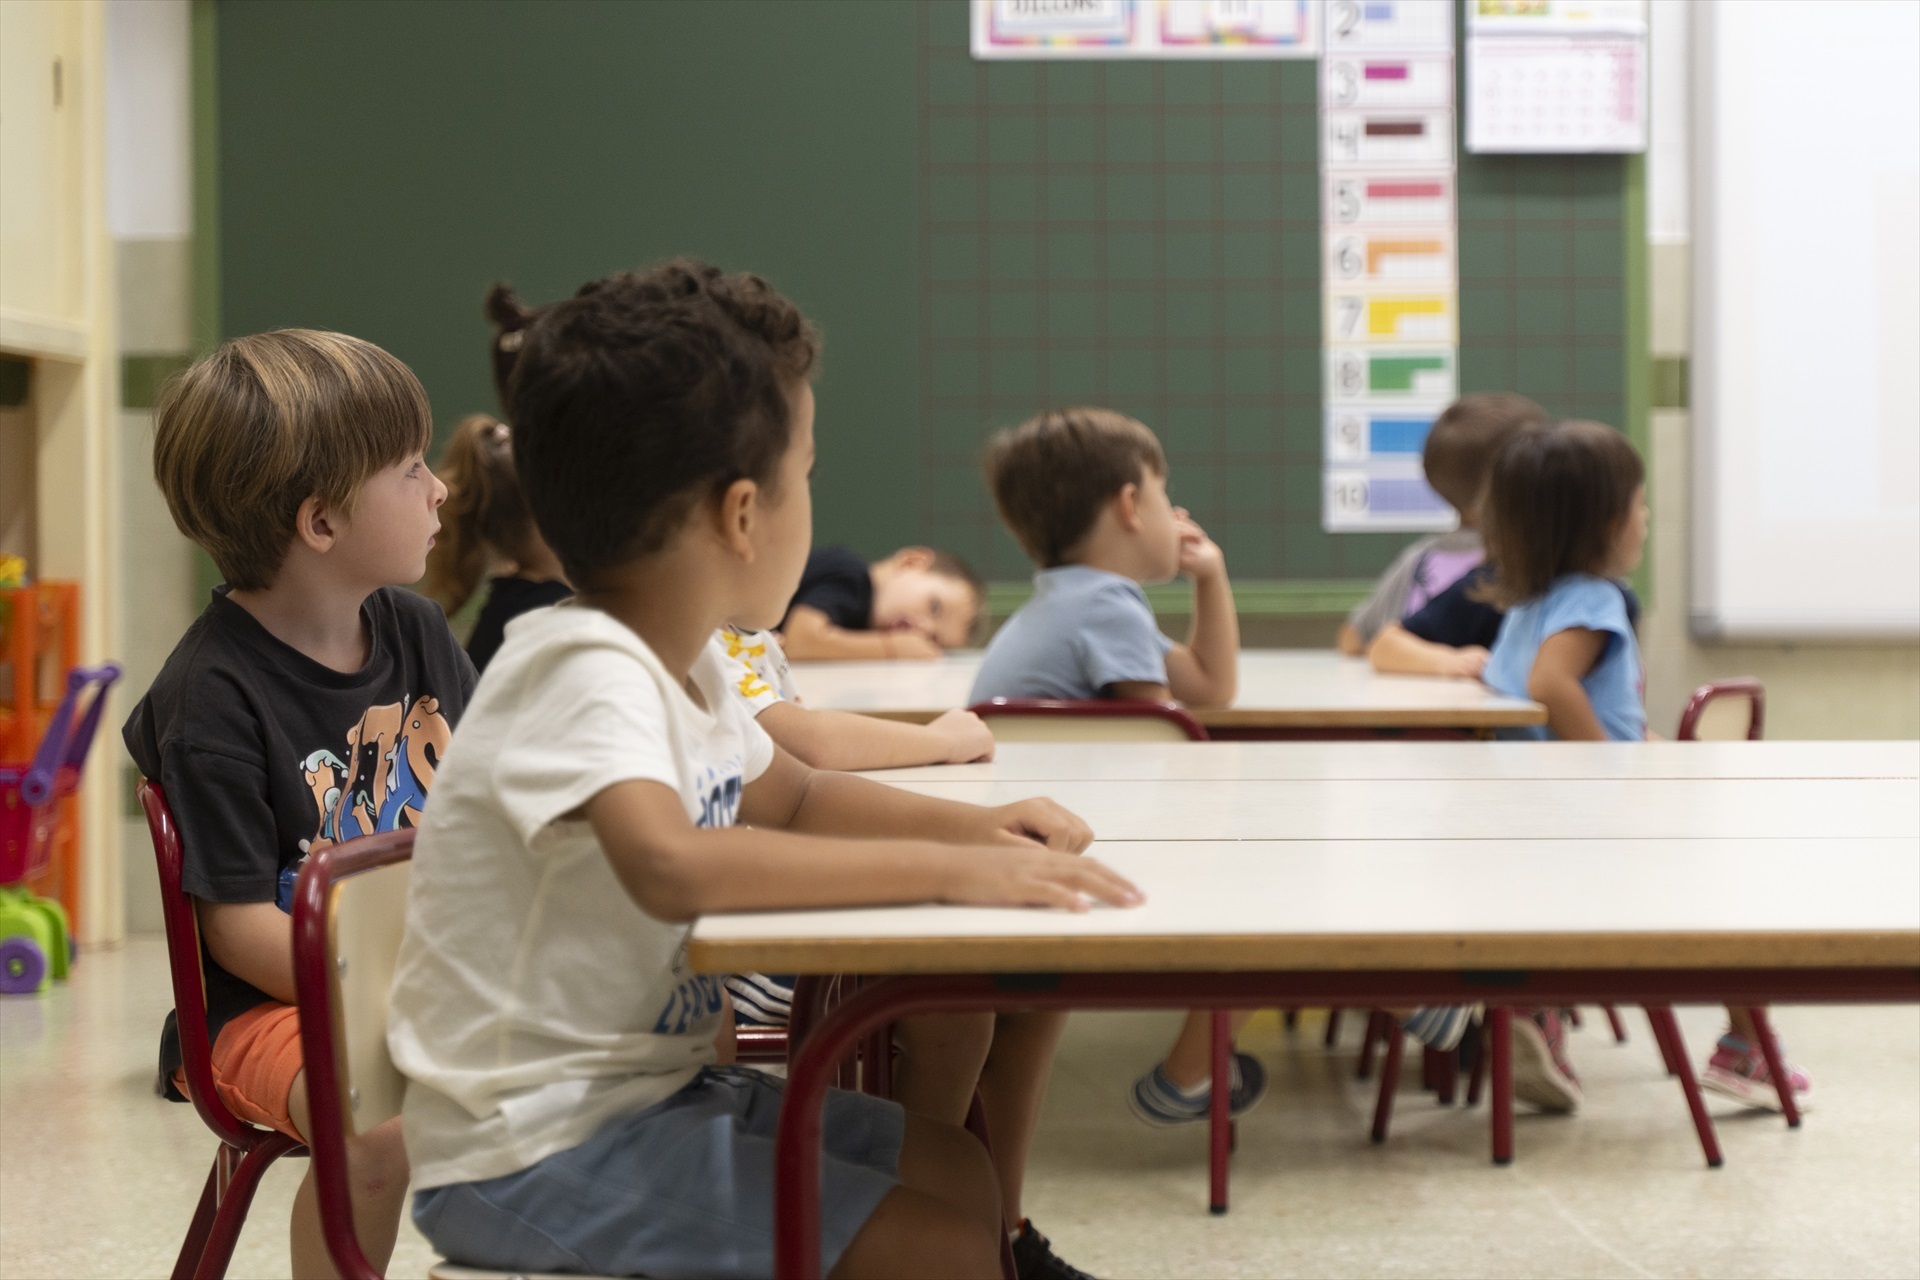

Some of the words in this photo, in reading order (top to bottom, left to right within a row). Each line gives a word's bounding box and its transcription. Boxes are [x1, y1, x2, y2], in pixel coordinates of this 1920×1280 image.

[1331, 0, 1361, 40] 2
[1332, 61, 1358, 106] 3
[1334, 121, 1359, 161] 4
[1335, 179, 1361, 223] 5
[1335, 236, 1362, 280] 6
[1337, 295, 1363, 338] 7
[1338, 352, 1363, 396] 8
[1338, 415, 1361, 456] 9
[1335, 479, 1369, 512] 10
